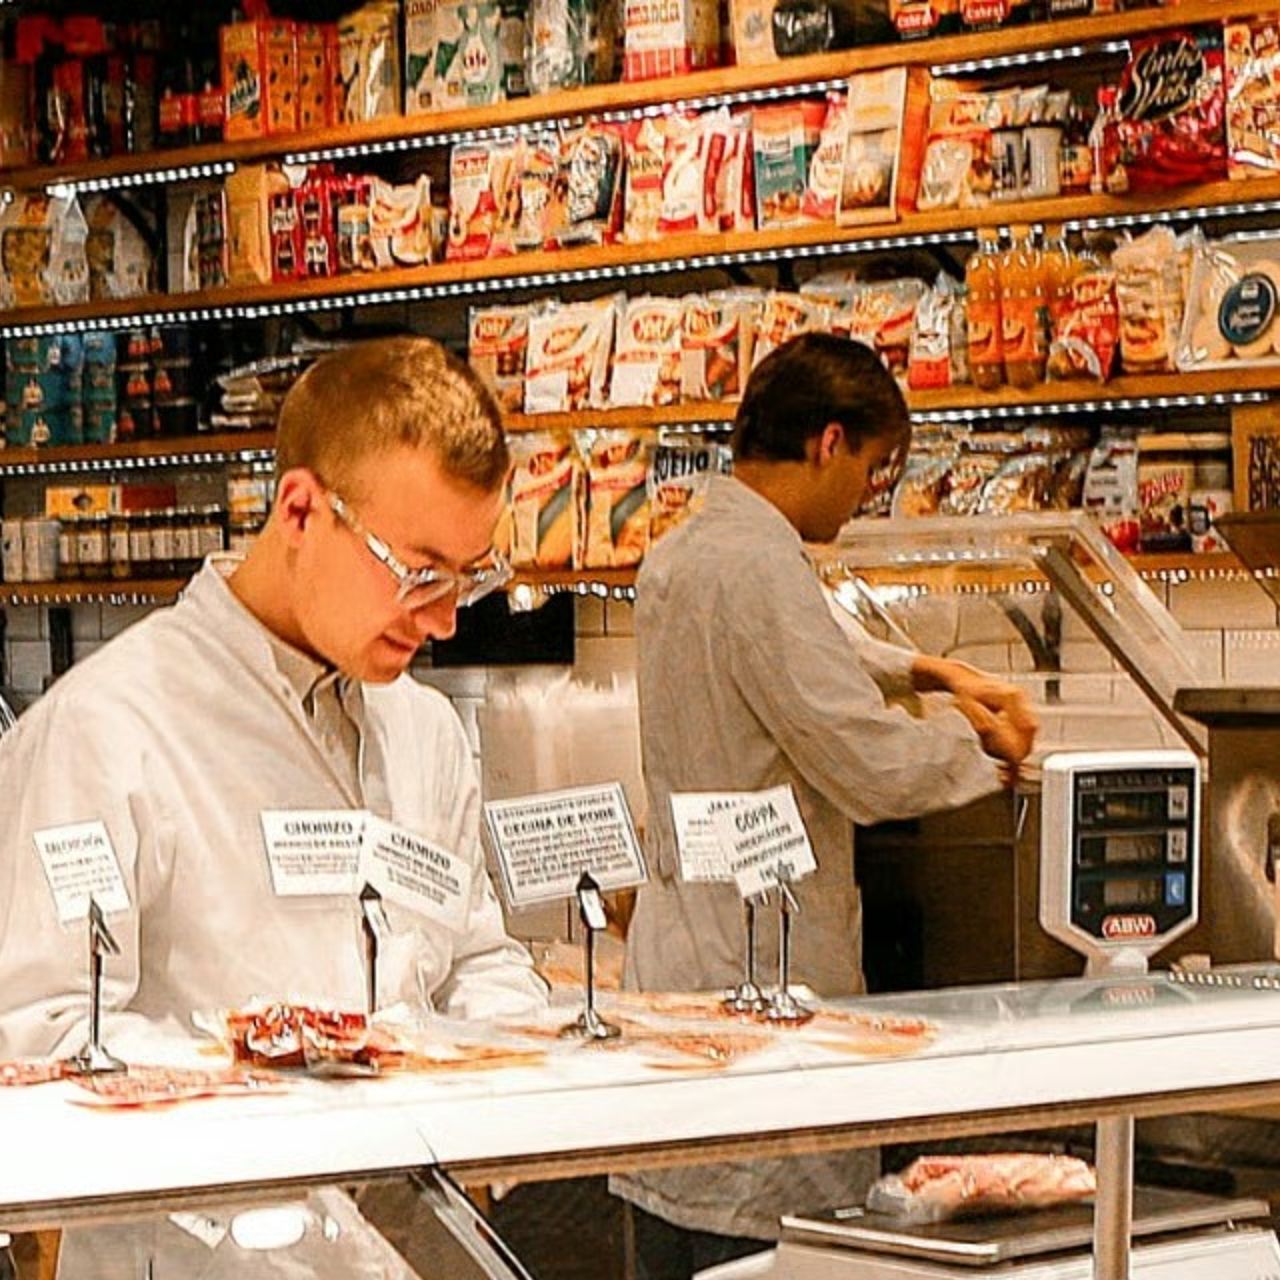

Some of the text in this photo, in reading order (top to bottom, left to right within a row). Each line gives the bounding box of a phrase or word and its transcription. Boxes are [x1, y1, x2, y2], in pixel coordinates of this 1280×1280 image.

[284, 820, 353, 836] CHORIZO
[556, 811, 576, 827] DE
[391, 832, 451, 869] CHORIZO
[1108, 915, 1151, 938] ABW
